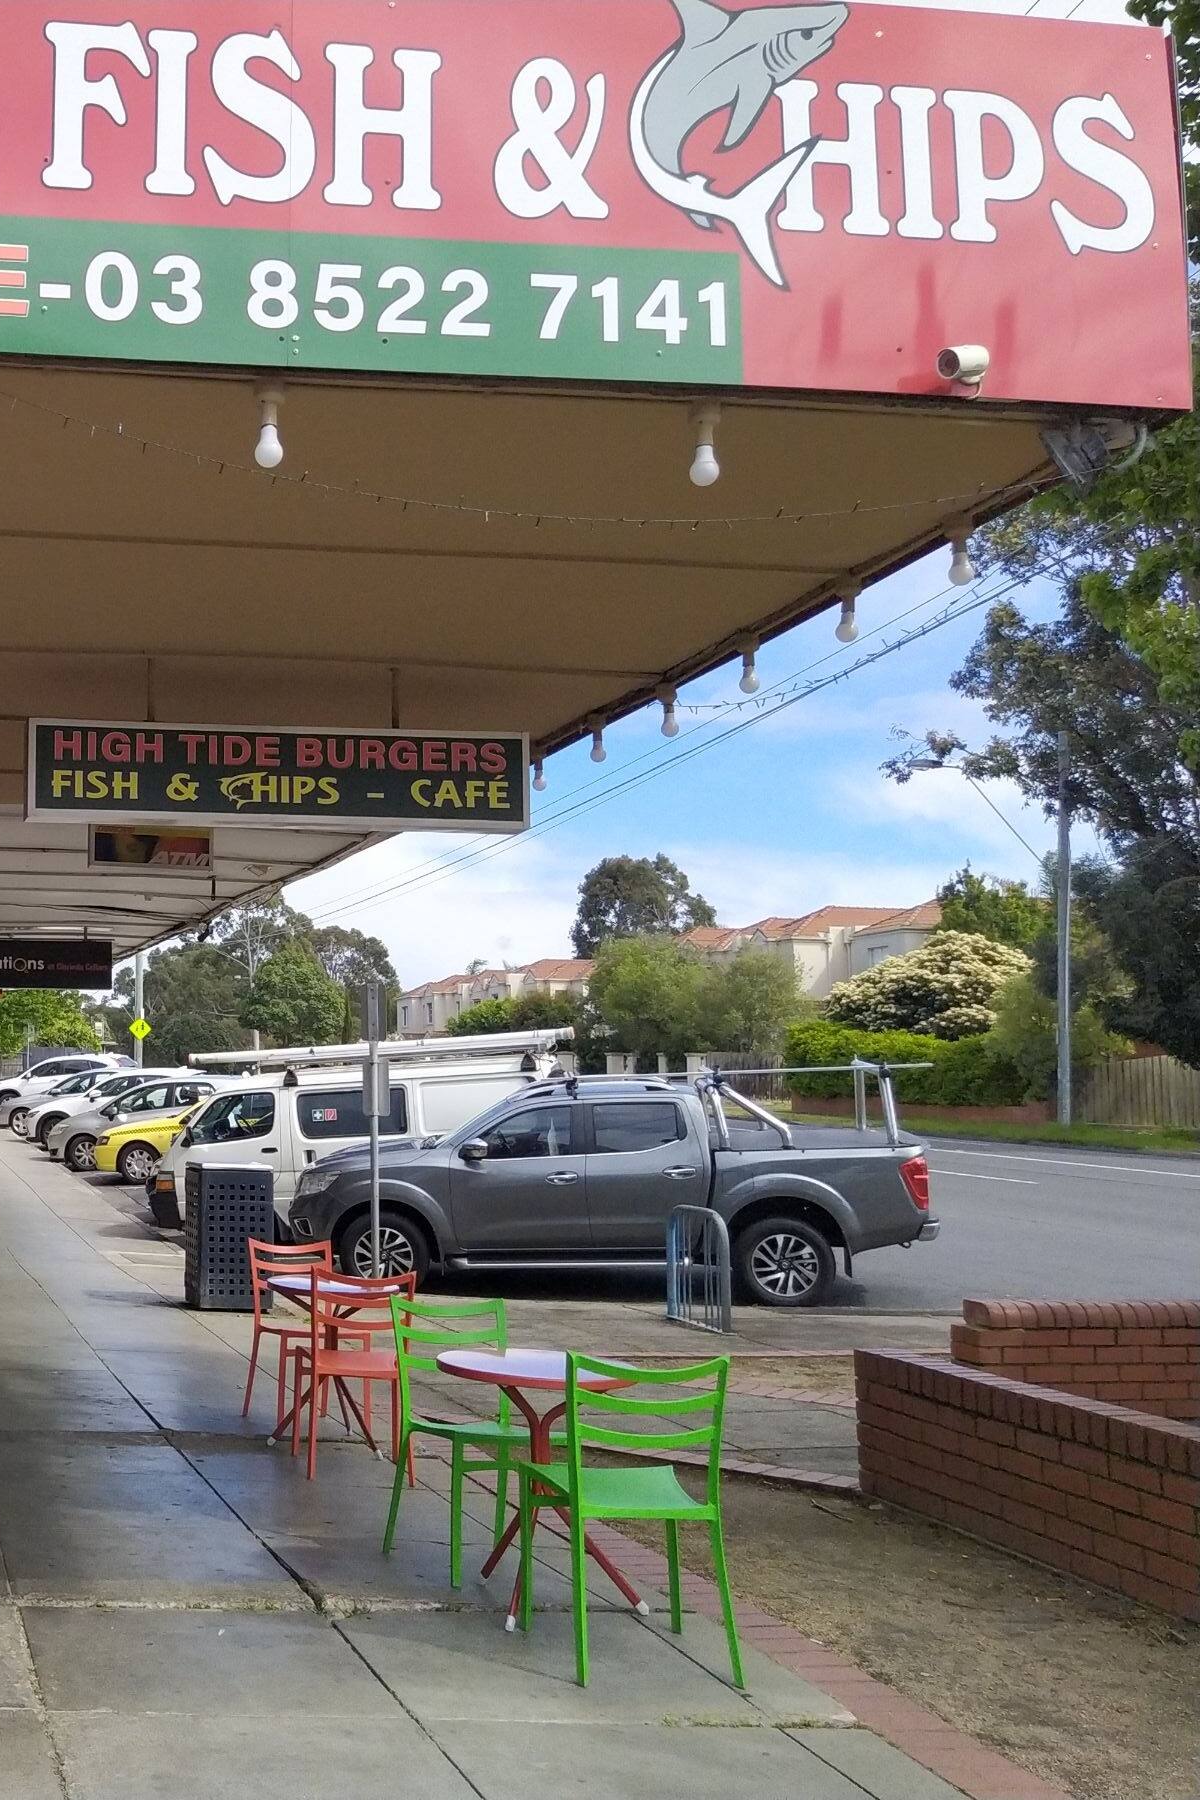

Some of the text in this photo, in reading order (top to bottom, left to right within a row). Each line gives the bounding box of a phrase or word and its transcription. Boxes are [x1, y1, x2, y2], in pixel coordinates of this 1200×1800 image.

[41, 20, 443, 211] FISH
[493, 57, 610, 219] &
[246, 258, 492, 338] 8522
[529, 272, 726, 348] 7141
[54, 730, 508, 773] HIGH TIDE BURGERS
[52, 769, 139, 800] FISH
[166, 772, 200, 802] &
[216, 772, 340, 811] CHIPS
[411, 775, 511, 809] CAFÉ
[148, 850, 209, 867] ATM
